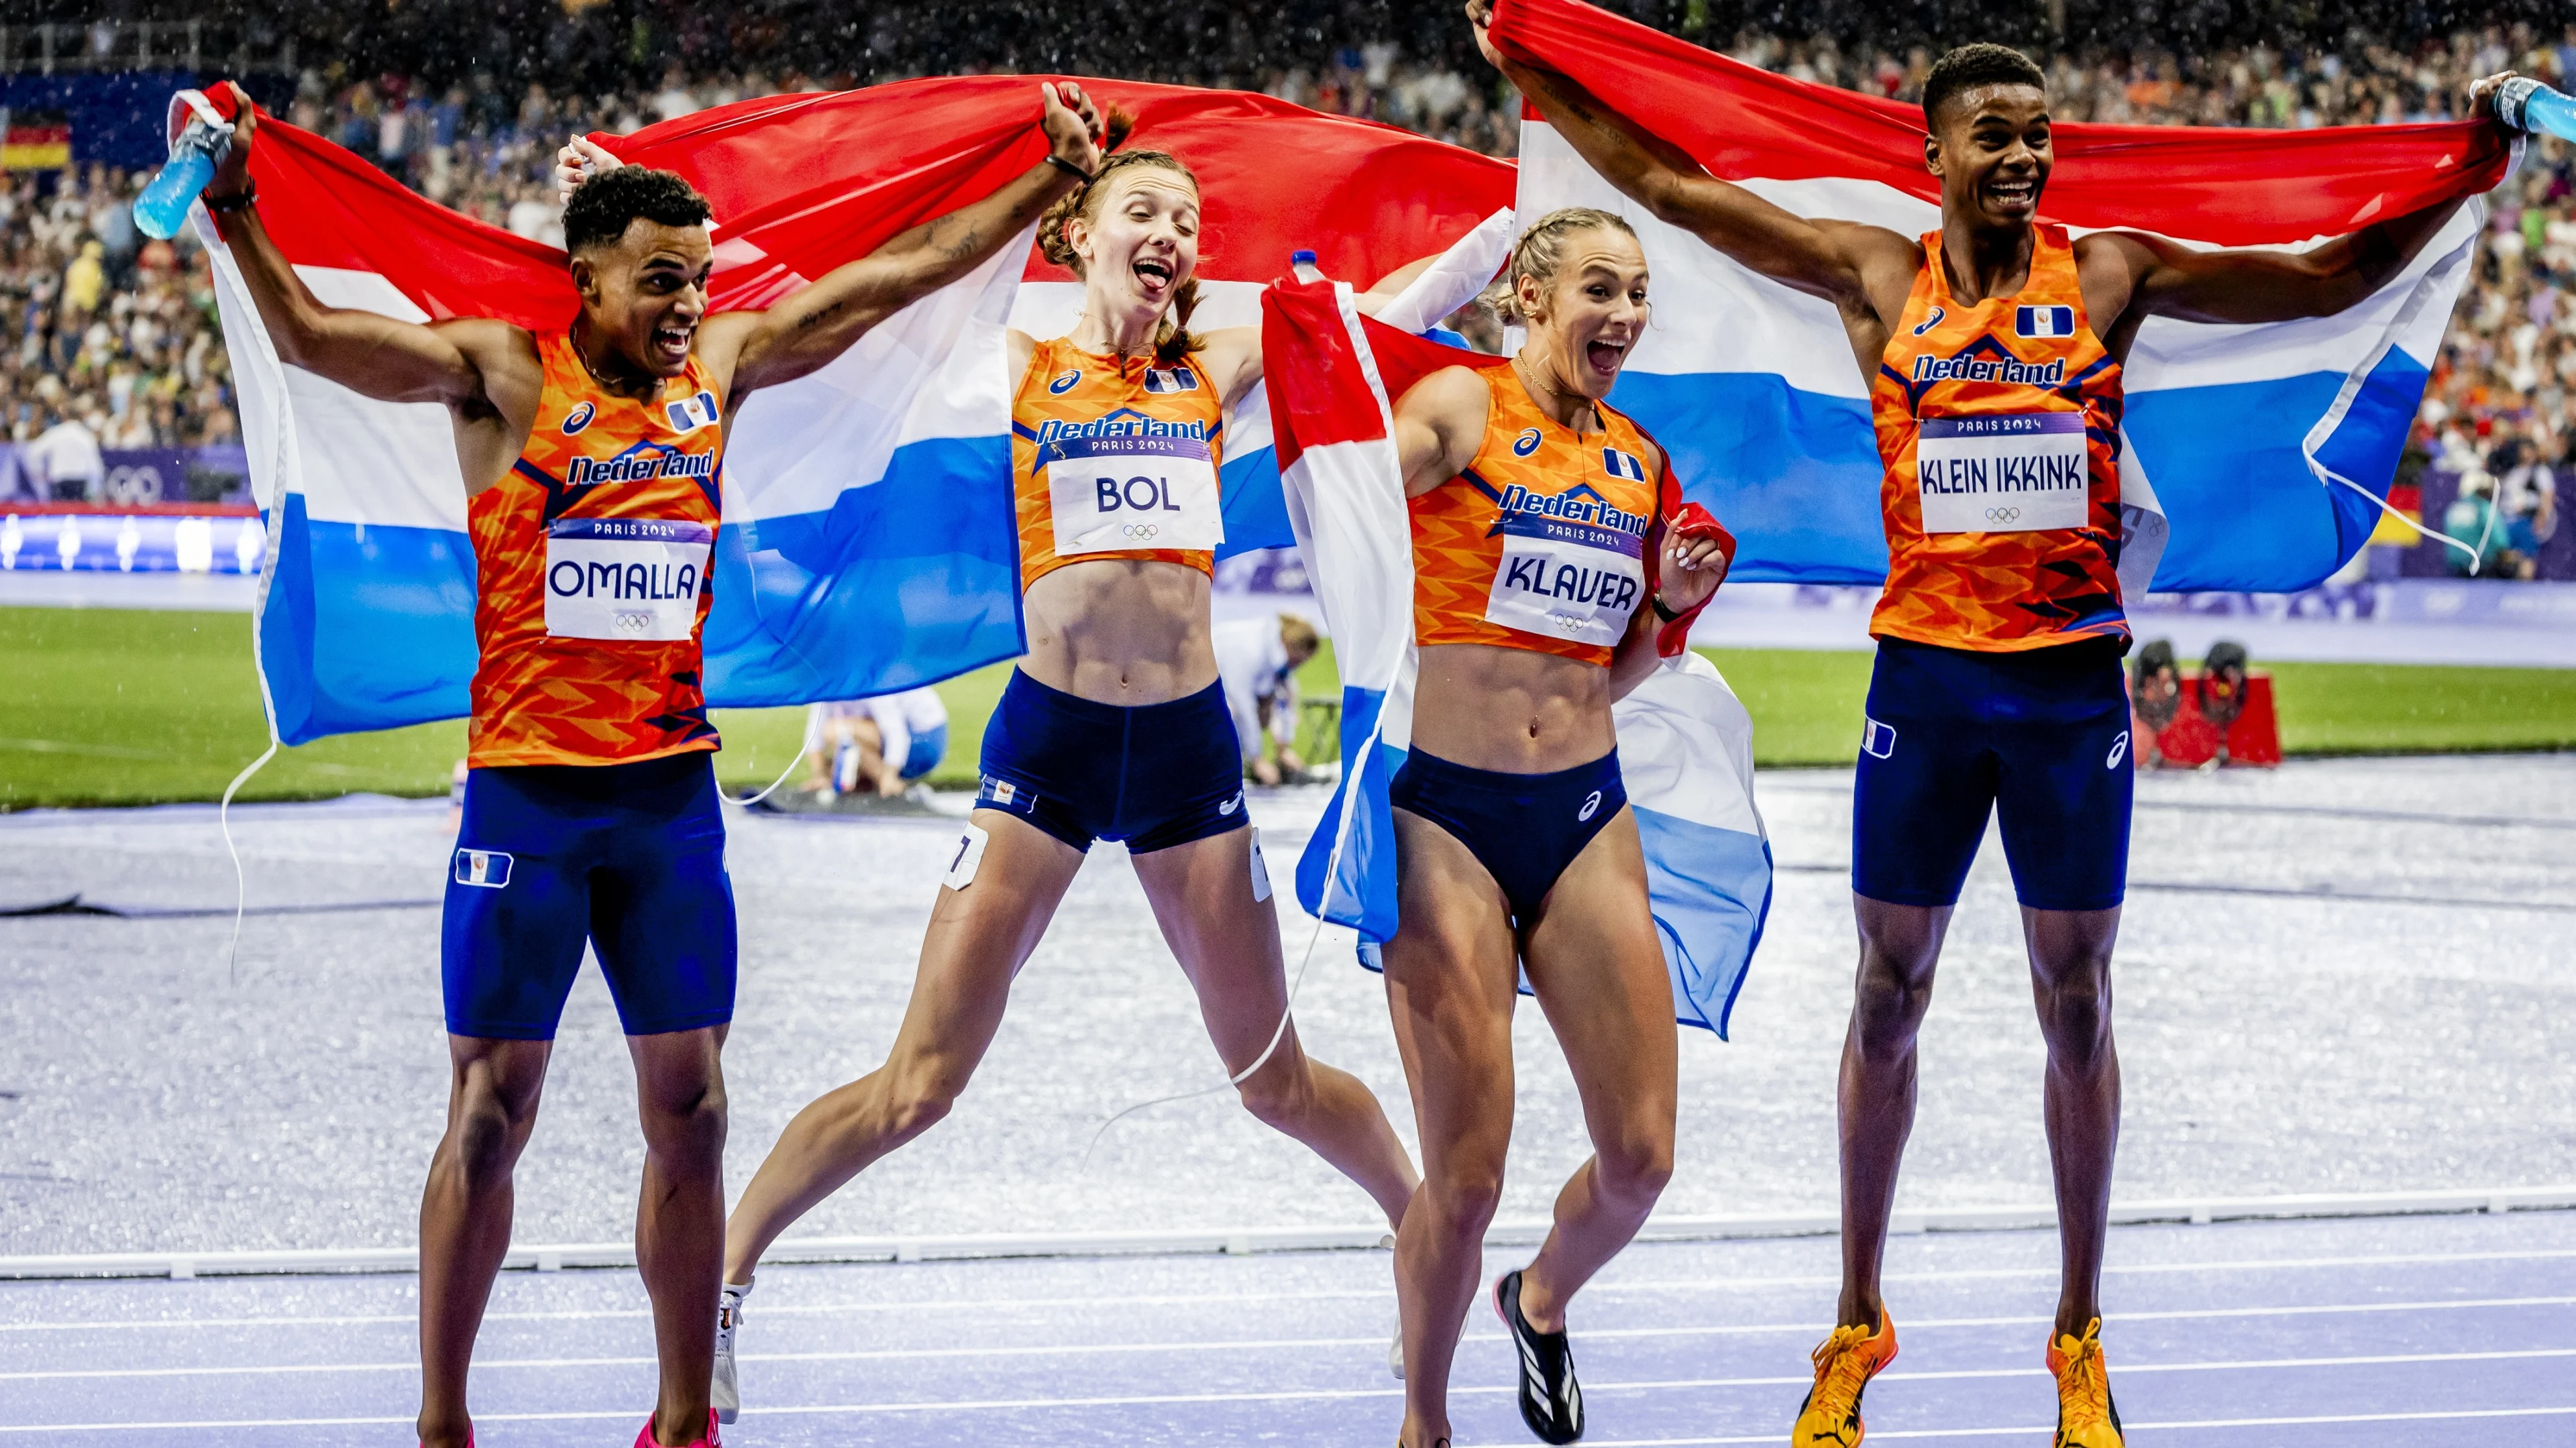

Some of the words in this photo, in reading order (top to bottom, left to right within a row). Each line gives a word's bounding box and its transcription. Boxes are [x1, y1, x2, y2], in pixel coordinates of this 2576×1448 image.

[1958, 420, 1998, 432] PARIS
[2004, 419, 2041, 430] 2024
[1092, 440, 1133, 451] PARIS
[1138, 440, 1174, 451] 2024
[1920, 457, 1988, 494] KLEIN
[1996, 454, 2082, 493] IKKINK
[1096, 476, 1181, 512] BOL
[594, 524, 637, 536] PARIS
[641, 524, 675, 537] 2024
[1548, 524, 1585, 539] PARIS
[1589, 531, 1619, 547] 2024
[549, 561, 696, 600] OMALLA
[1505, 556, 1637, 611] KLAVER
